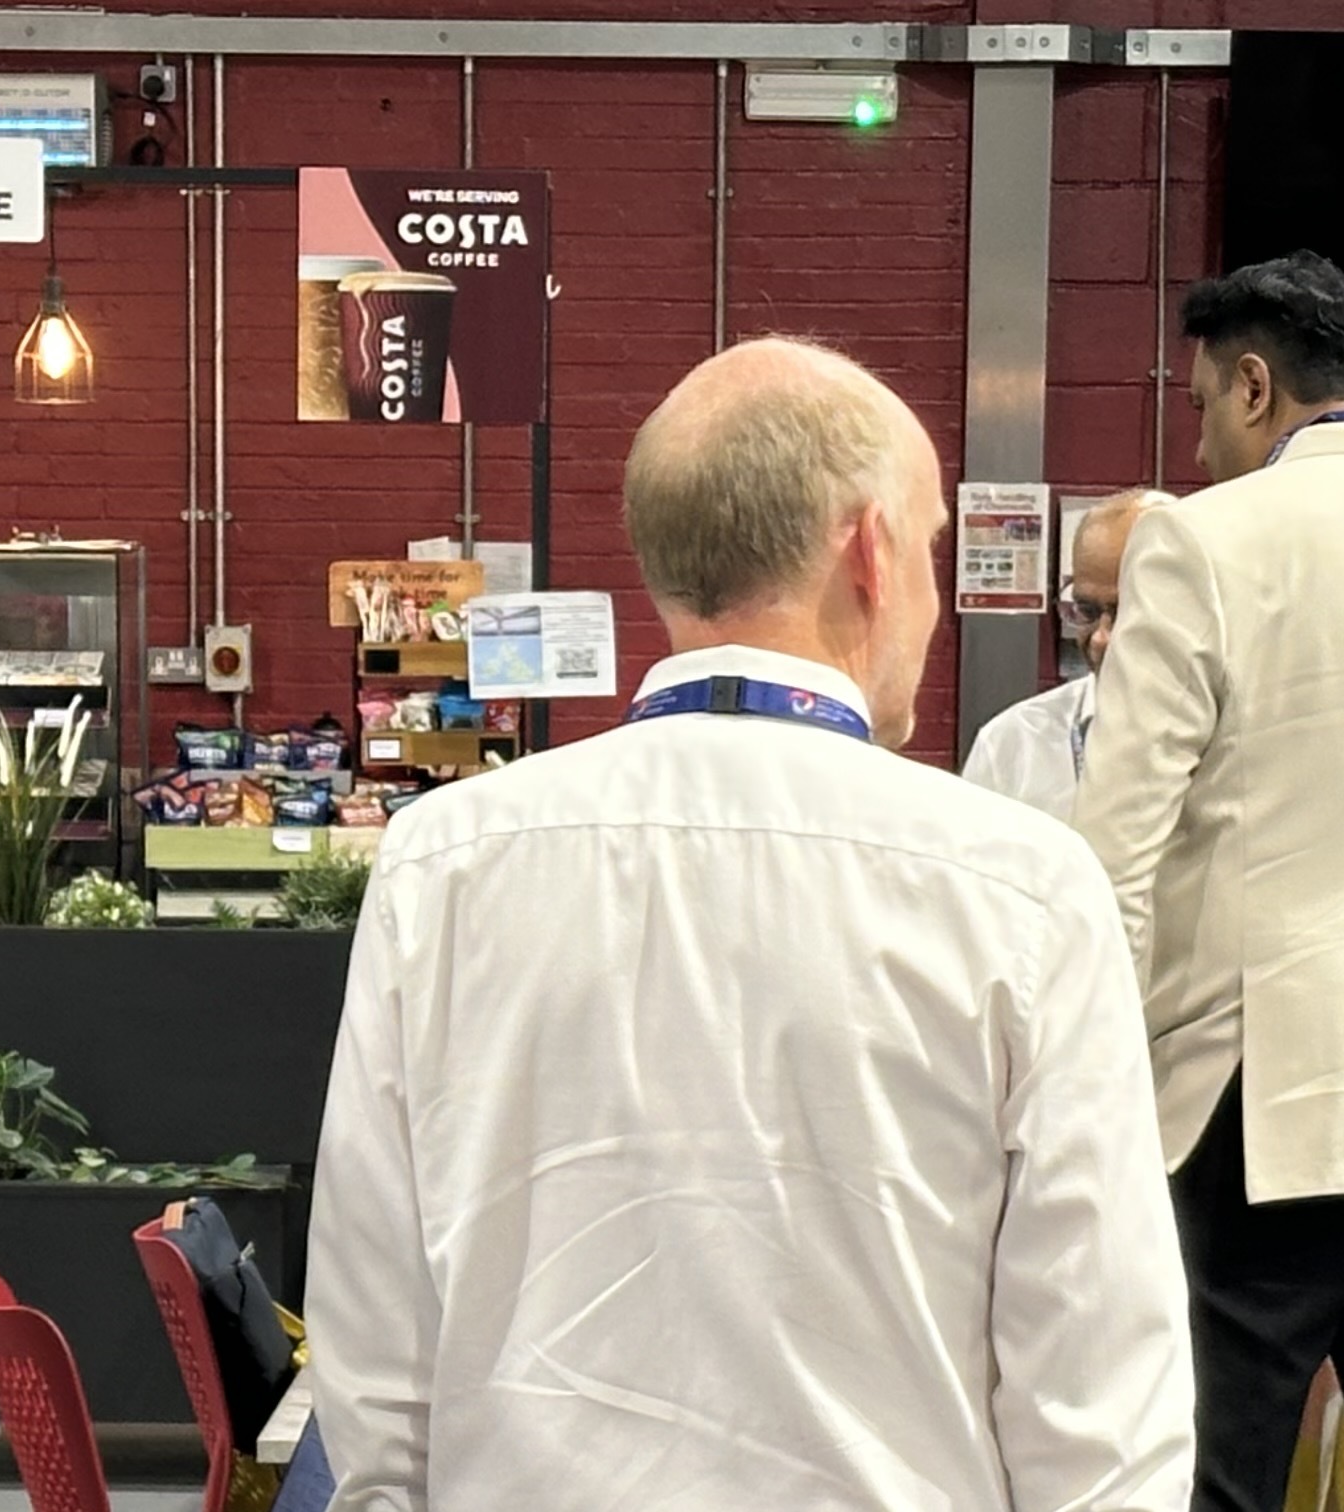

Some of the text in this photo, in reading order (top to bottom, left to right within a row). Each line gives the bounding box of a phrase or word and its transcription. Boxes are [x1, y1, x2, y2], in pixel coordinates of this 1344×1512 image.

[407, 189, 520, 204] WE'RE SERVING
[397, 213, 529, 249] COSTA
[427, 252, 500, 267] COFFEE
[380, 315, 408, 421] COSTA
[400, 569, 434, 583] time
[439, 569, 460, 582] for
